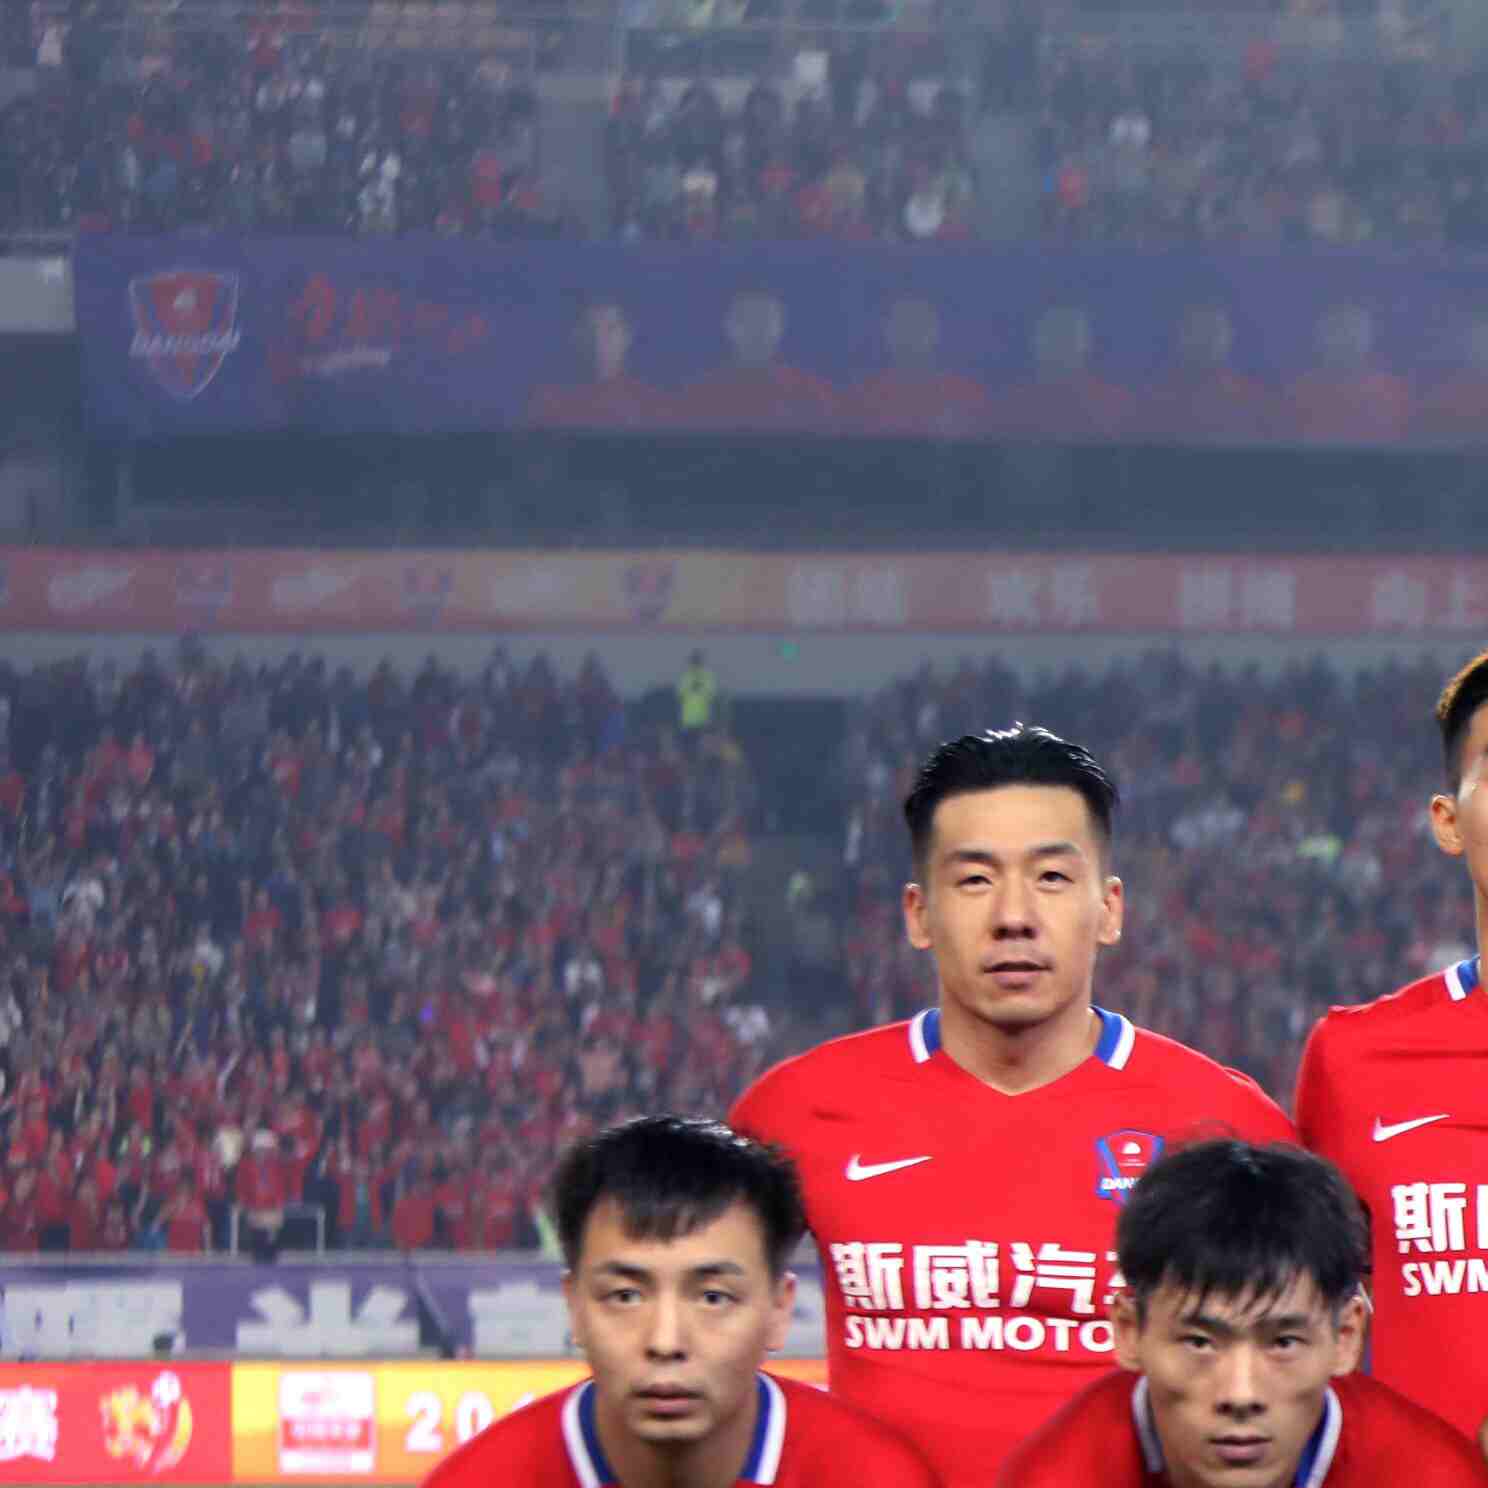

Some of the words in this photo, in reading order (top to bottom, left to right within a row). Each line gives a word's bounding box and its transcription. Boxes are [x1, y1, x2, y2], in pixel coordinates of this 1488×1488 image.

[831, 1240, 1126, 1313] 斯威汽
[844, 1317, 950, 1350] SWM
[960, 1317, 1116, 1352] MOTO
